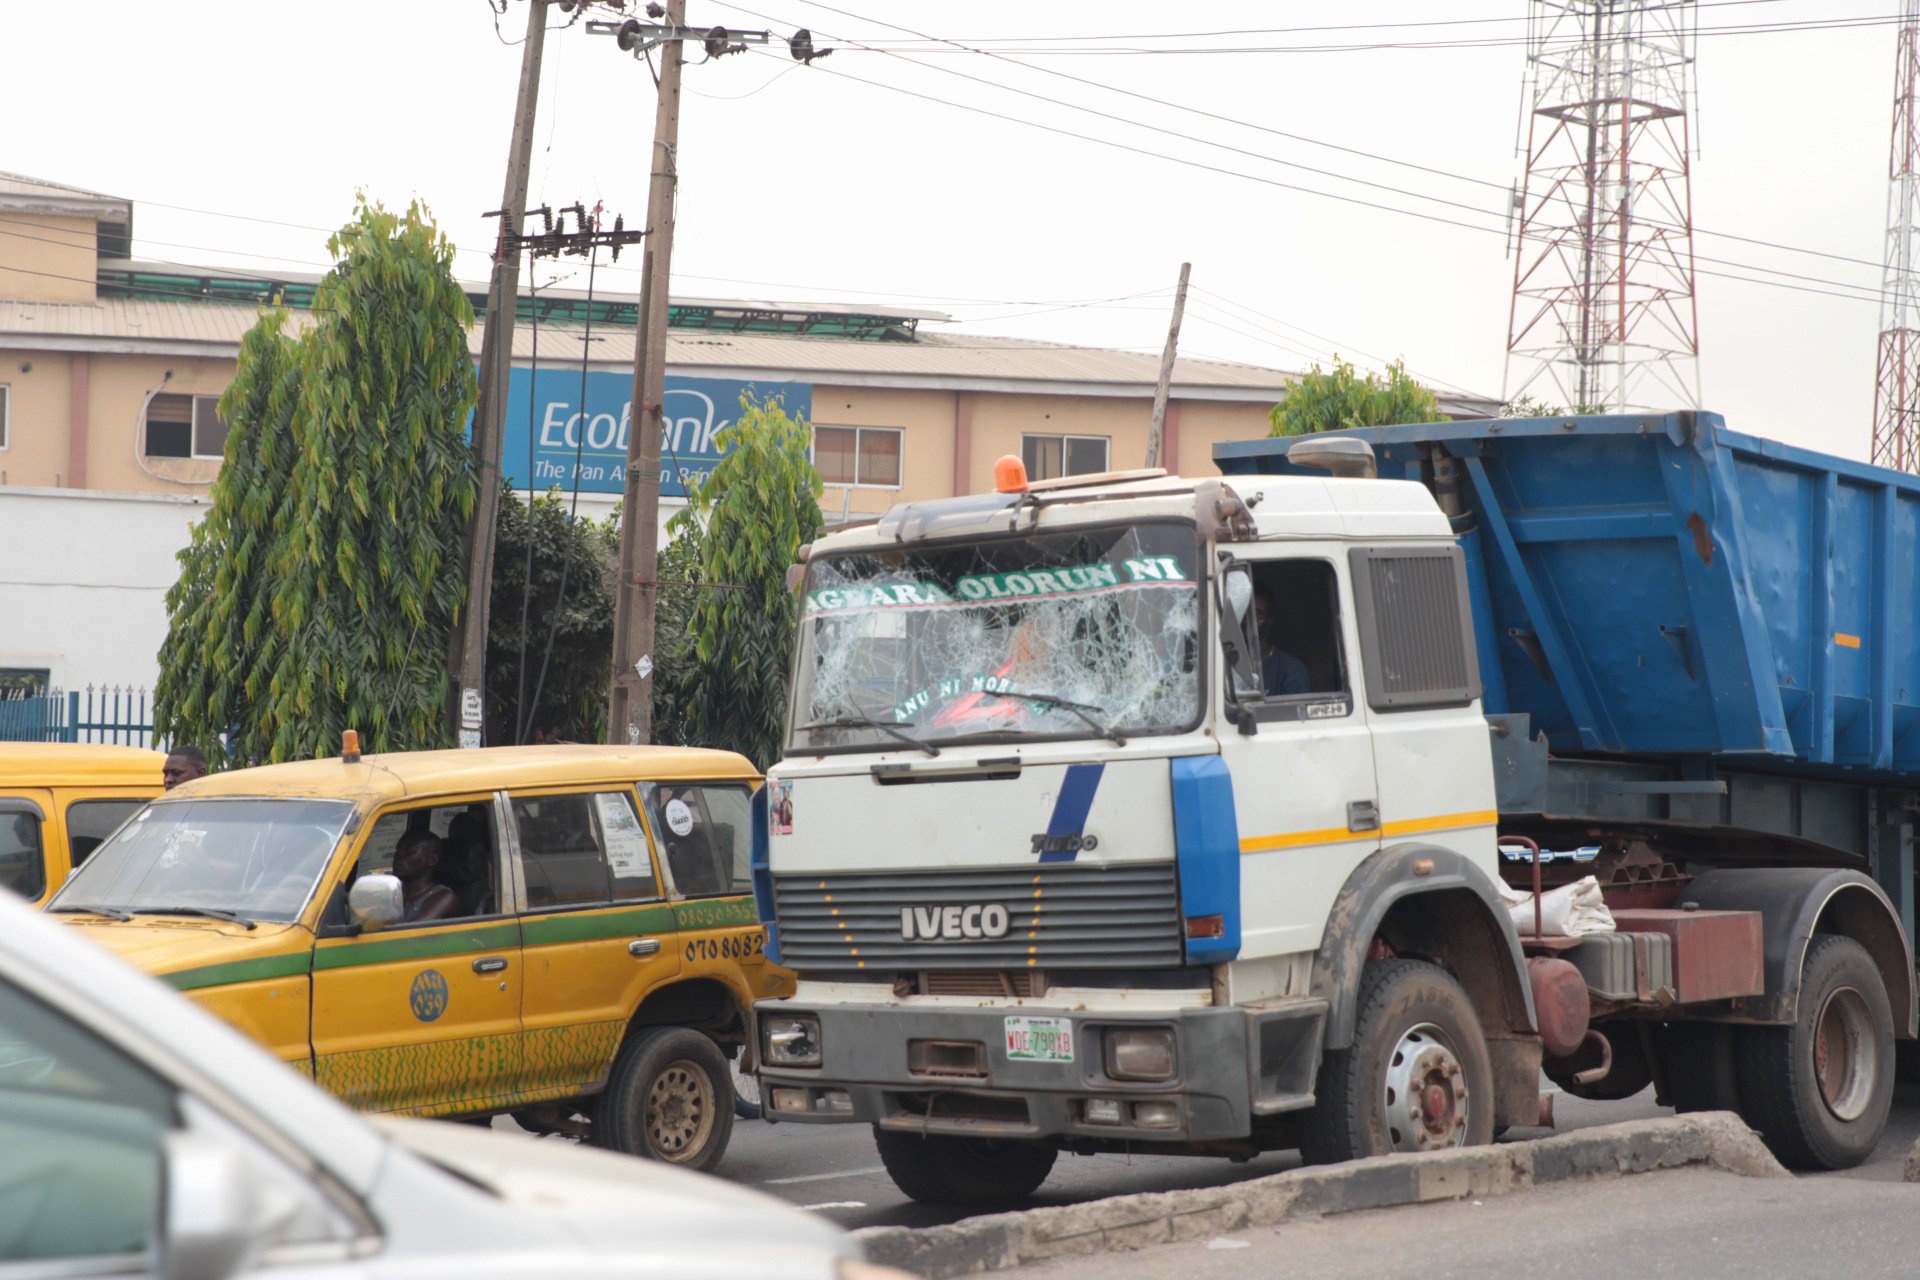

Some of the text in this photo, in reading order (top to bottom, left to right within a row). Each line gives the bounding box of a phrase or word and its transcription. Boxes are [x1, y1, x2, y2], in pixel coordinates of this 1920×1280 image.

[535, 461, 565, 478] The
[572, 463, 603, 481] Pan
[677, 467, 713, 485] Ban
[805, 558, 1185, 612] AGARA OLORUN NI
[894, 690, 929, 722] ANU
[901, 904, 1009, 939] IVECO
[685, 934, 763, 962] 0708082
